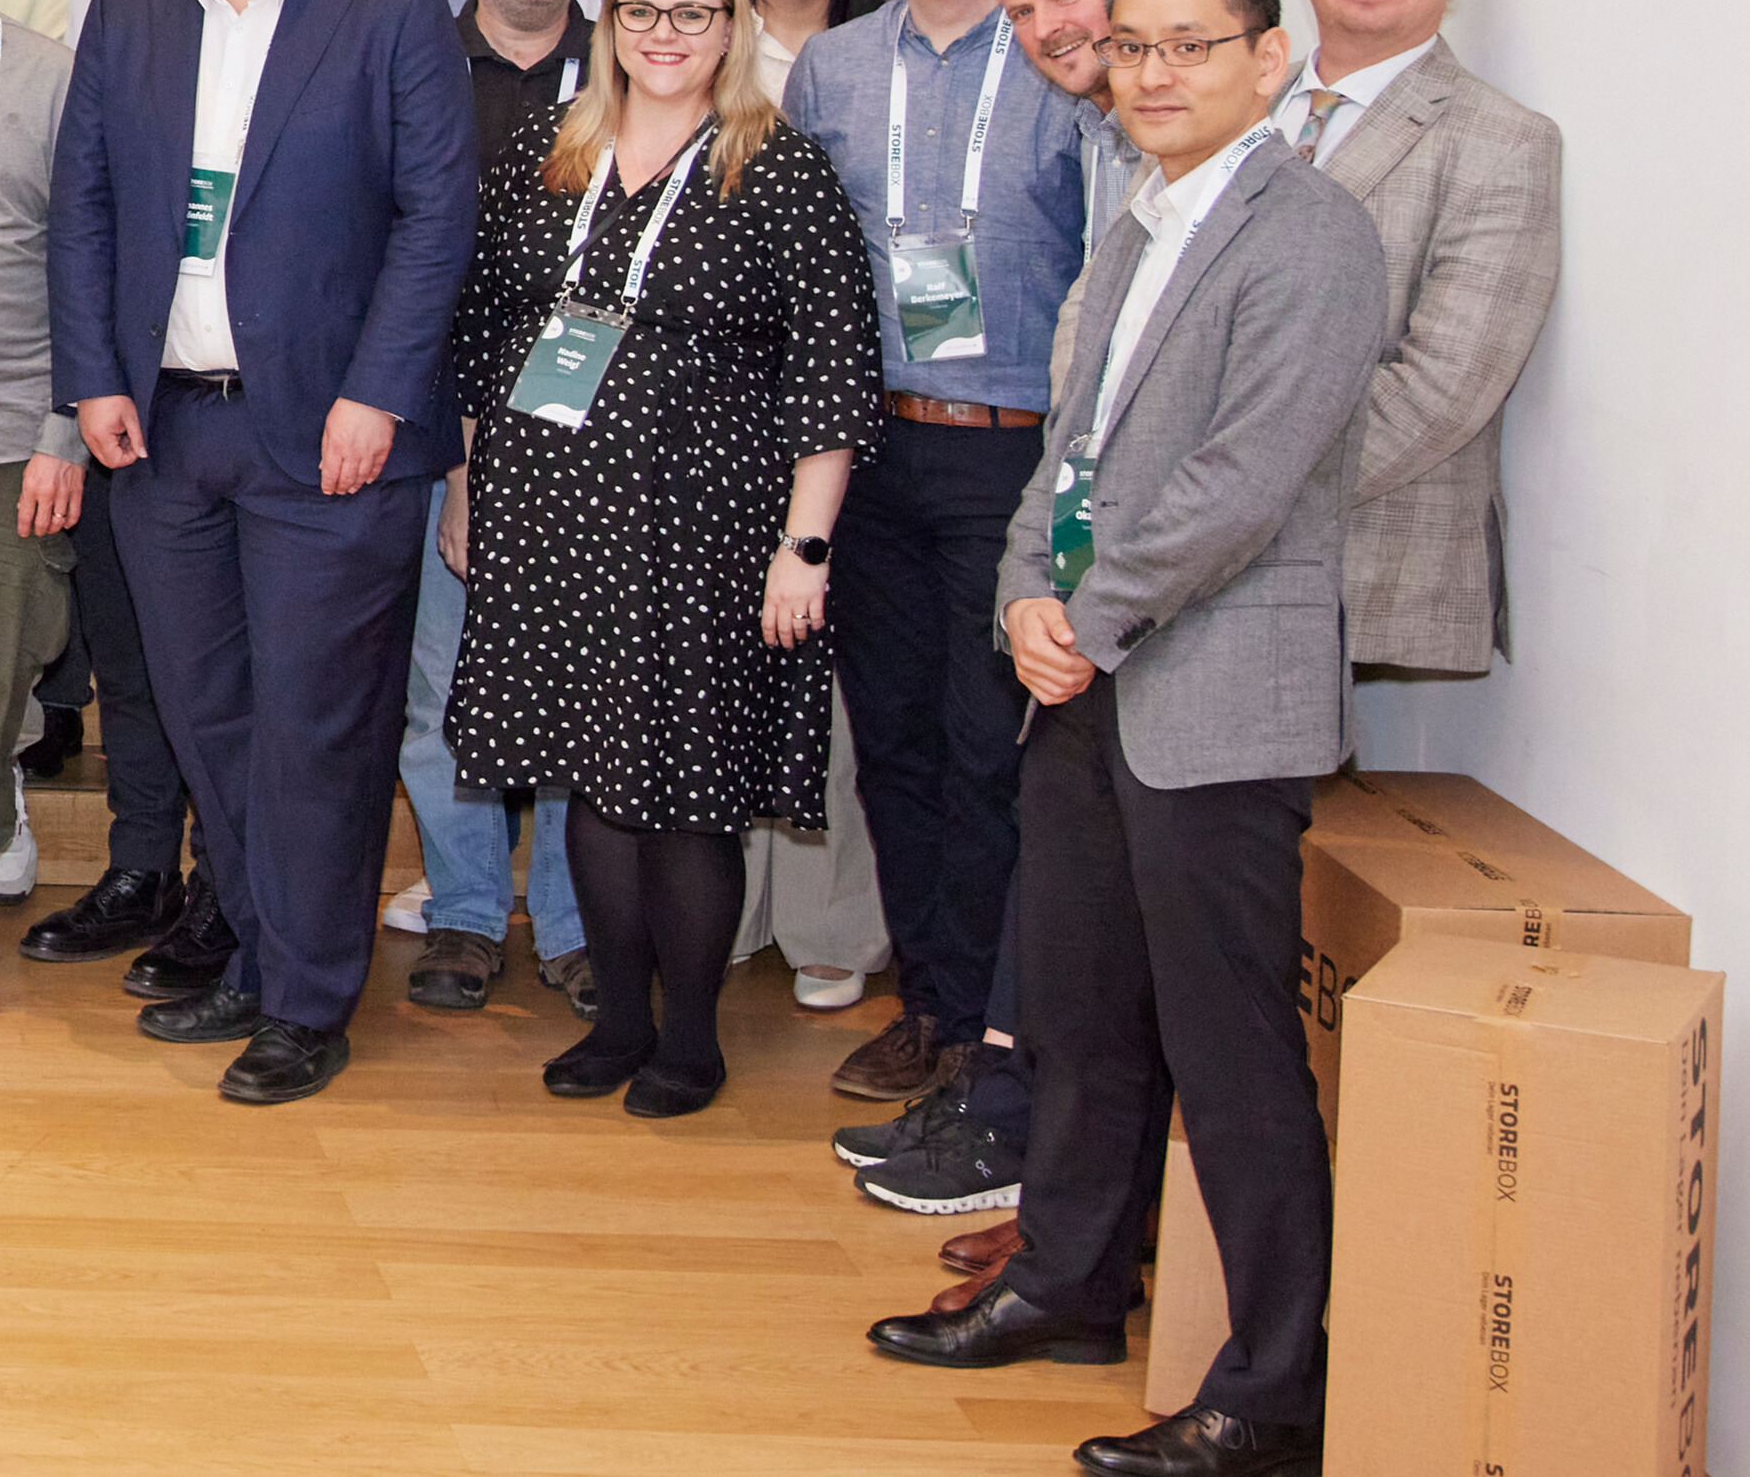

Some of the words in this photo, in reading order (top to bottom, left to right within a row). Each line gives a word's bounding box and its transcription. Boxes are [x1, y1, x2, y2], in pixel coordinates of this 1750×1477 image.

[972, 93, 994, 153] STOREBOX
[1220, 123, 1273, 173] STOREBOX
[890, 123, 902, 186] STOREBOX
[577, 183, 598, 231] STOREBOX
[650, 176, 683, 224] STOREBOX
[926, 282, 946, 293] Ralf
[1497, 1082, 1518, 1203] STOREBOX
[1678, 1017, 1708, 1477] STOREB
[1489, 1274, 1512, 1394] STOREBOX
